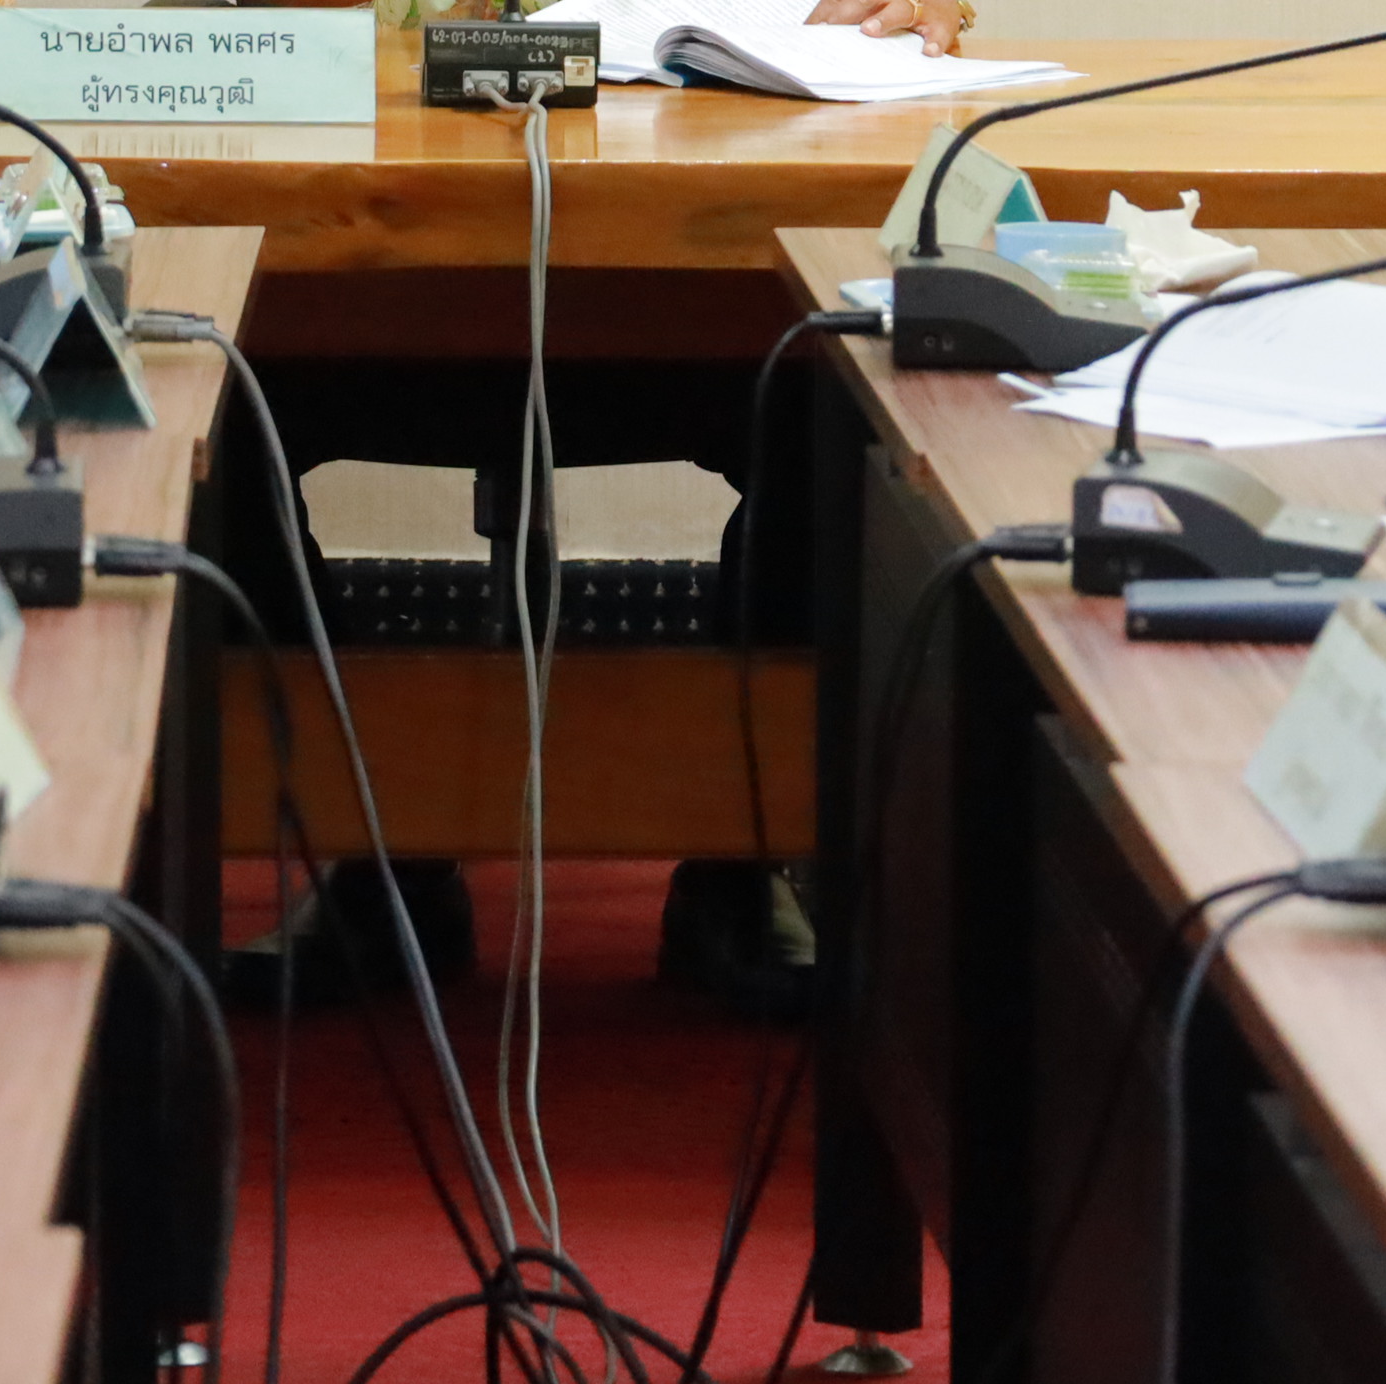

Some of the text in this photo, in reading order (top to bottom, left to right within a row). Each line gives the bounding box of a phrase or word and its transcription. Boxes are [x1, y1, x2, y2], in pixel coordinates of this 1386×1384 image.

[40, 23, 297, 54] นายอำพล พลศร
[81, 75, 255, 113] ผู้ทรงคุณวุฒิ
